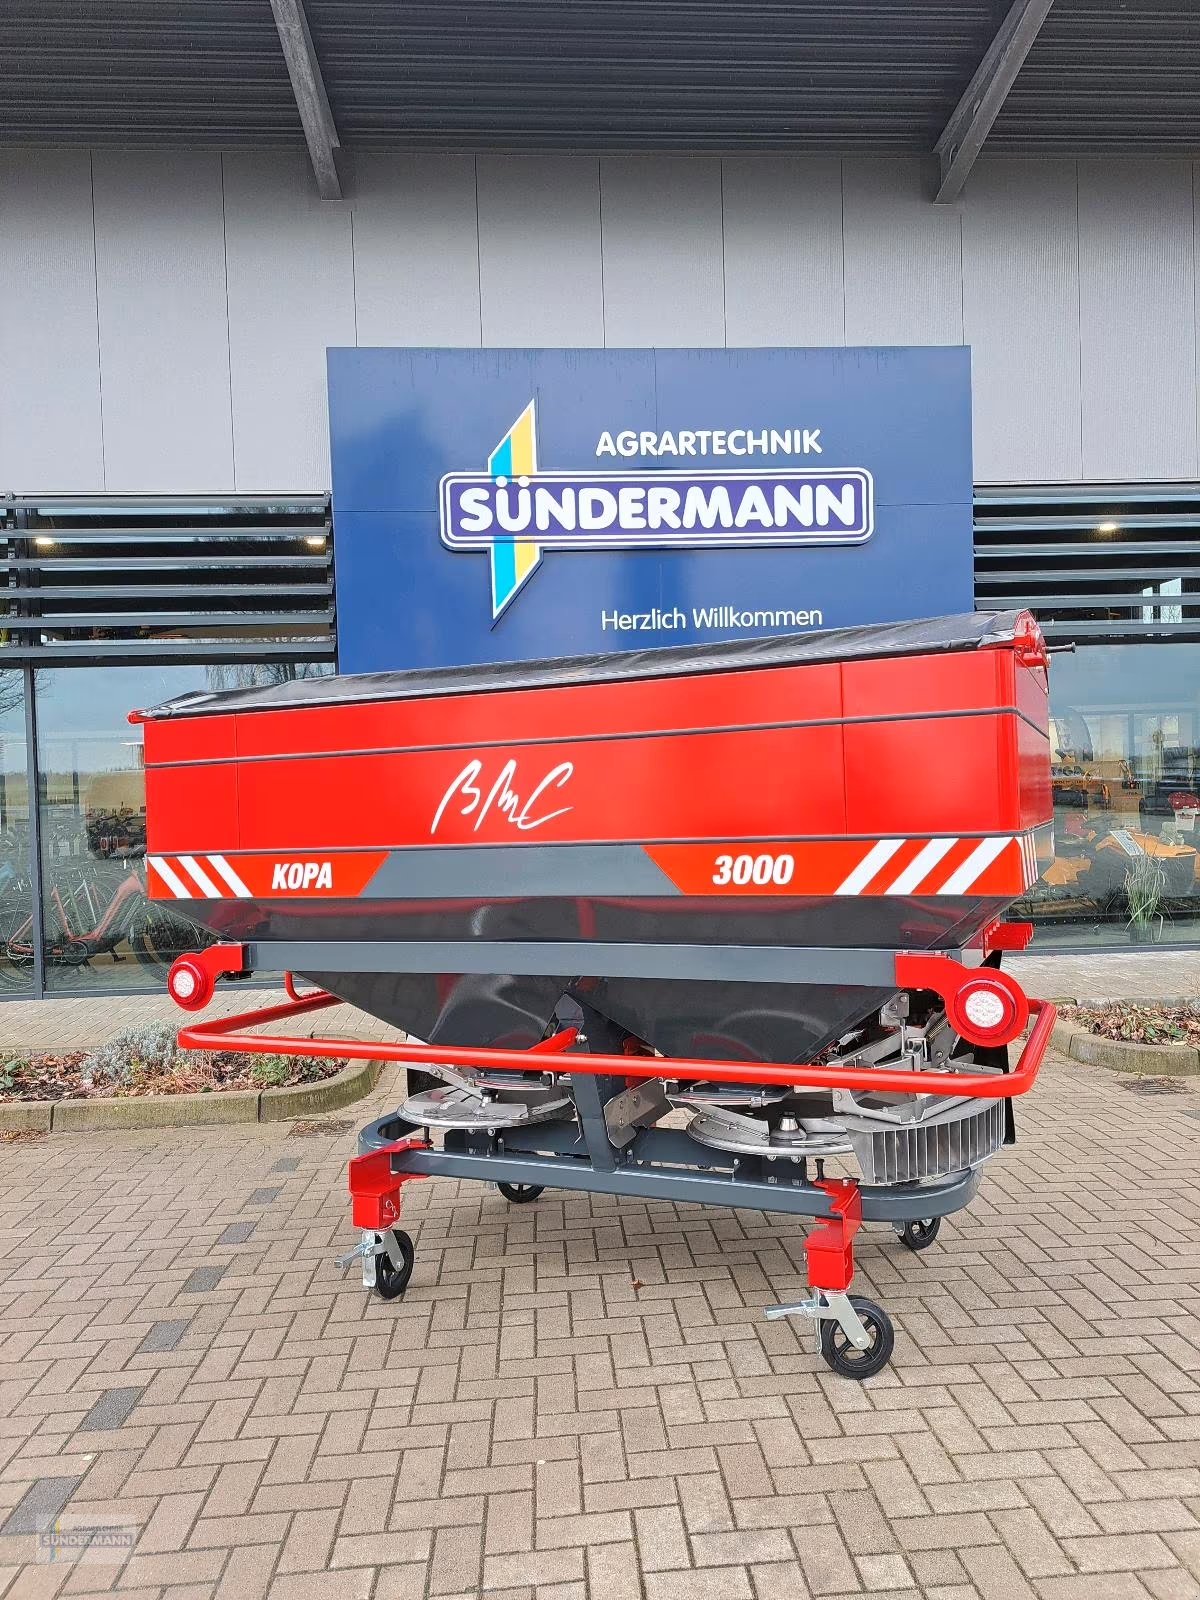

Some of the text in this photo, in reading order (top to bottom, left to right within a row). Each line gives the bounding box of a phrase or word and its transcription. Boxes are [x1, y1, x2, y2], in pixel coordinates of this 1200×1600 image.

[595, 428, 823, 457] AGRARTECHNIK
[458, 475, 857, 532] SÜNDERMANN
[601, 605, 823, 631] Herzlich Willkommen
[271, 861, 333, 891] KOPA
[711, 854, 795, 886] 3000
